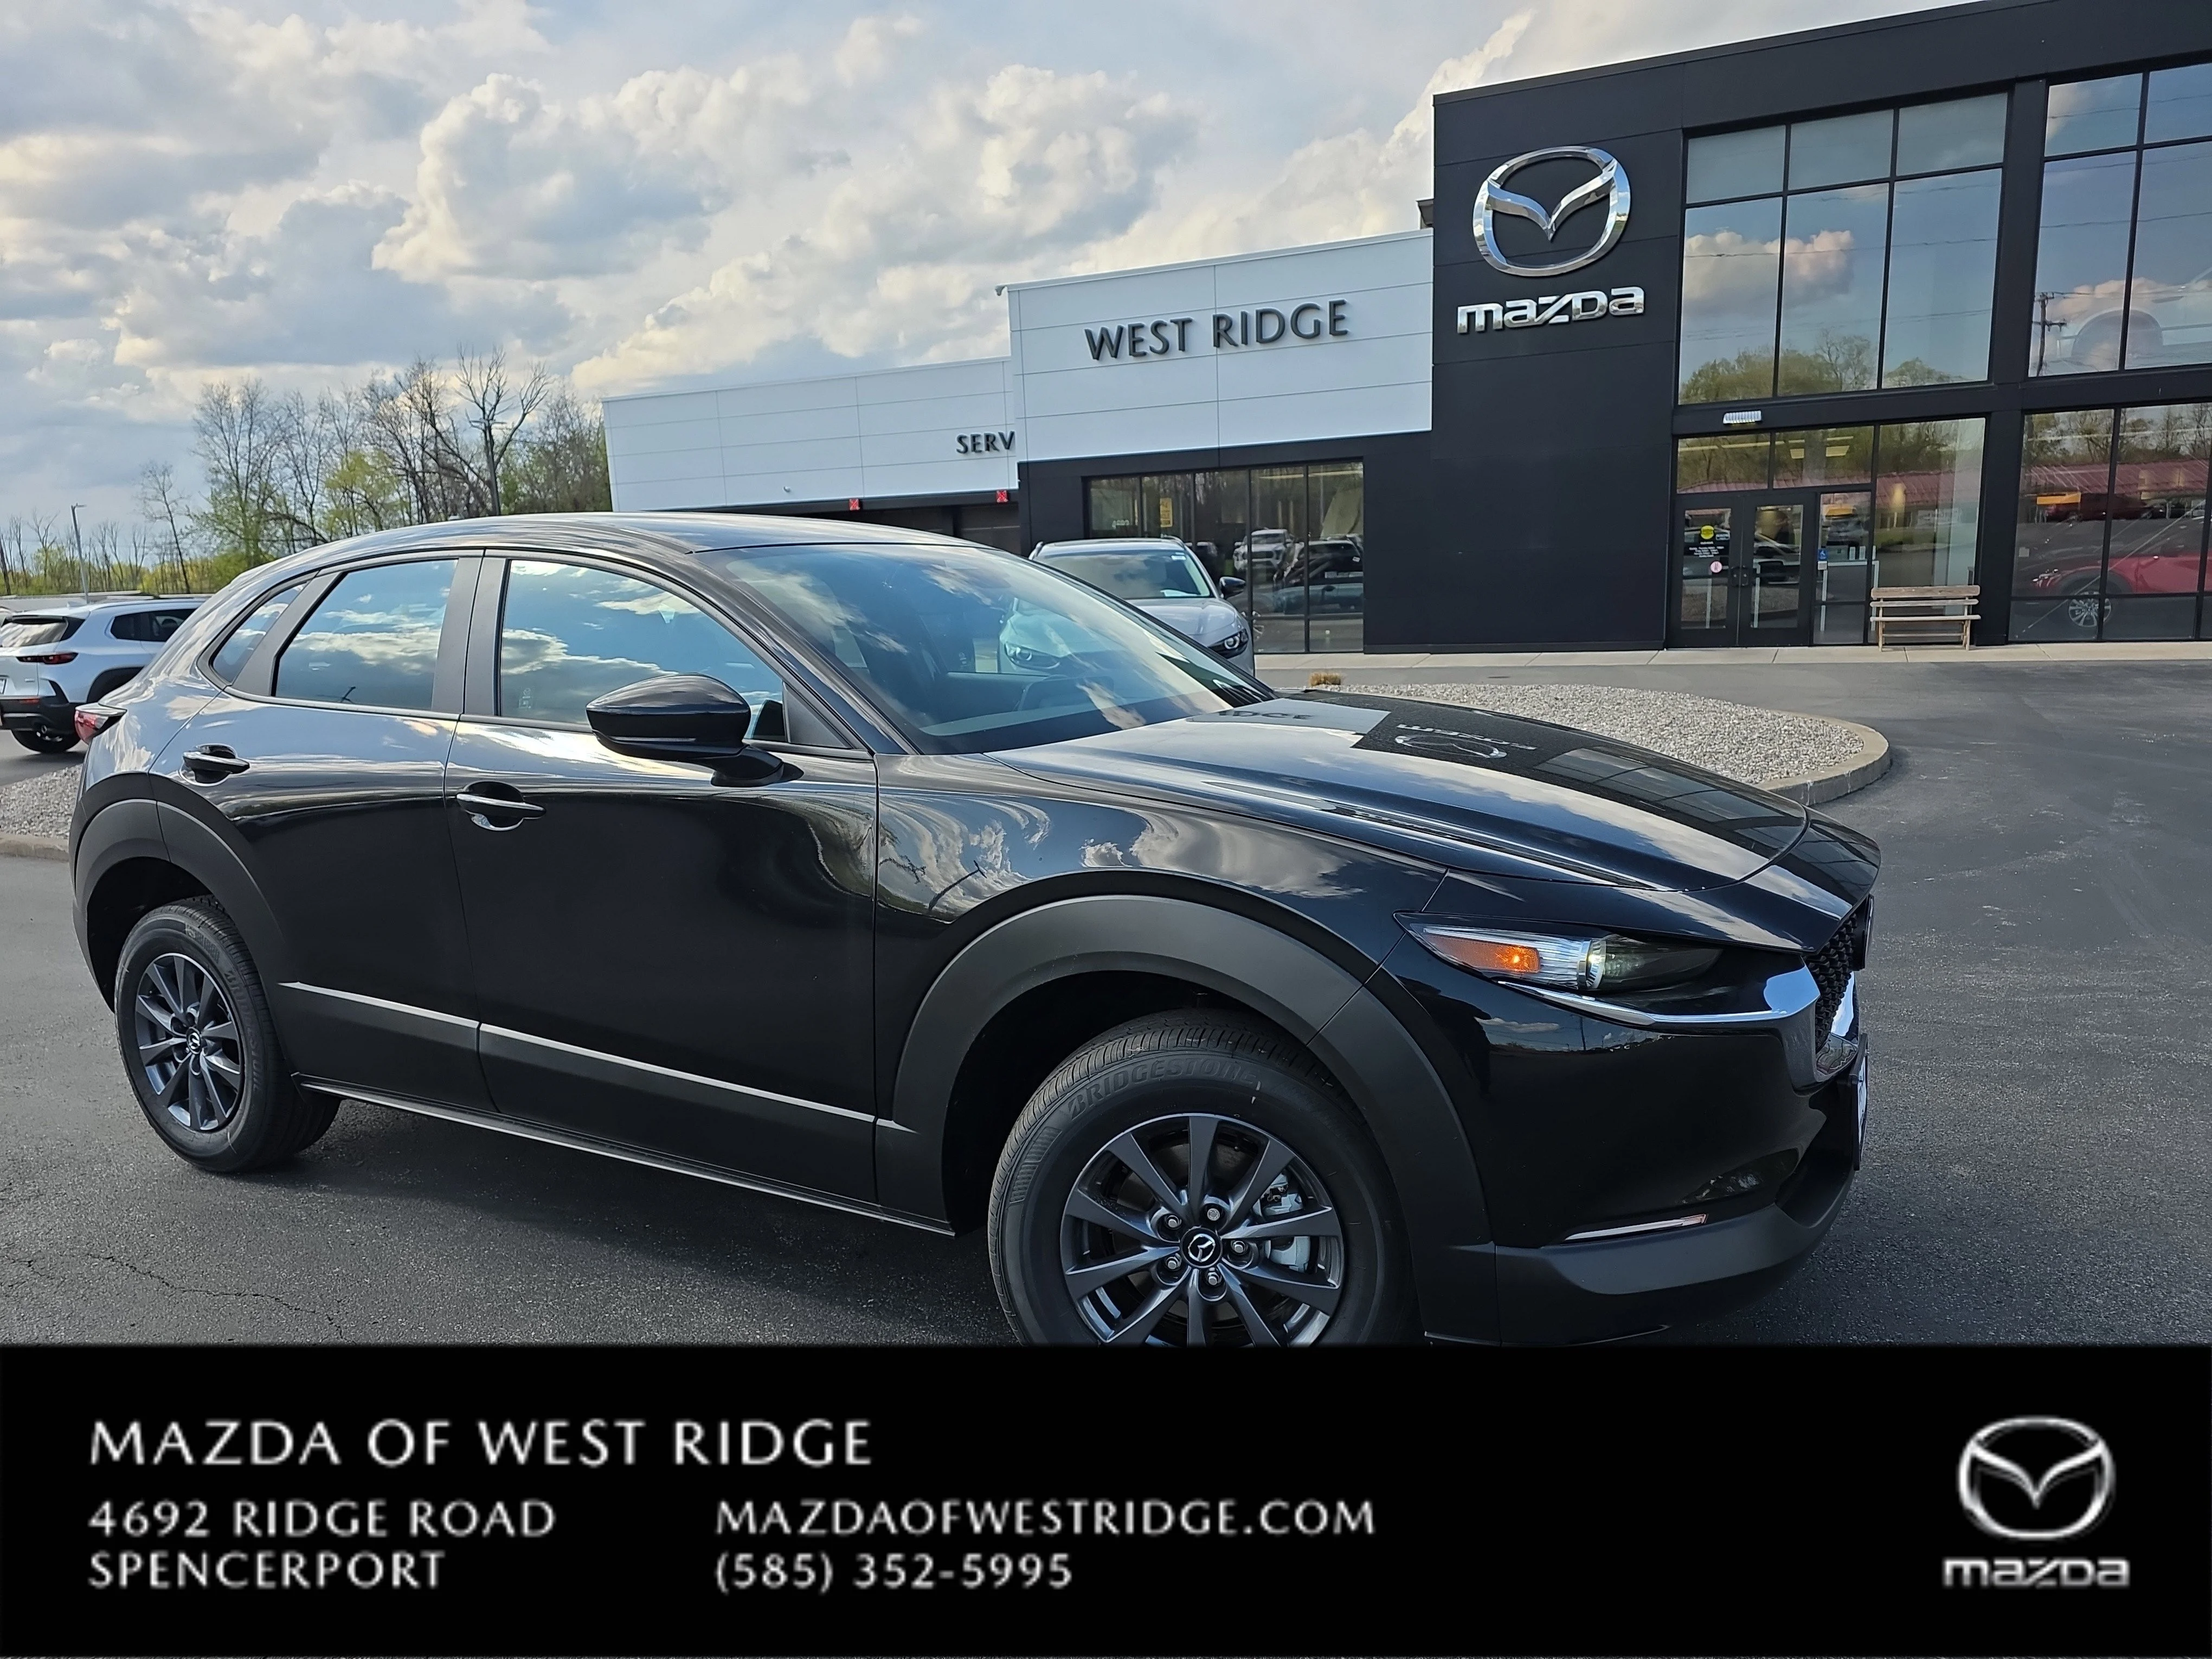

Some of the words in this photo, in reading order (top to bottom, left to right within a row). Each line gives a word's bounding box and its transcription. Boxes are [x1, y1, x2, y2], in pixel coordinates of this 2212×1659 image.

[1084, 317, 1193, 361] WEST
[1212, 299, 1349, 348] RIDGE
[1067, 1058, 1258, 1121] BRIDGESTONE
